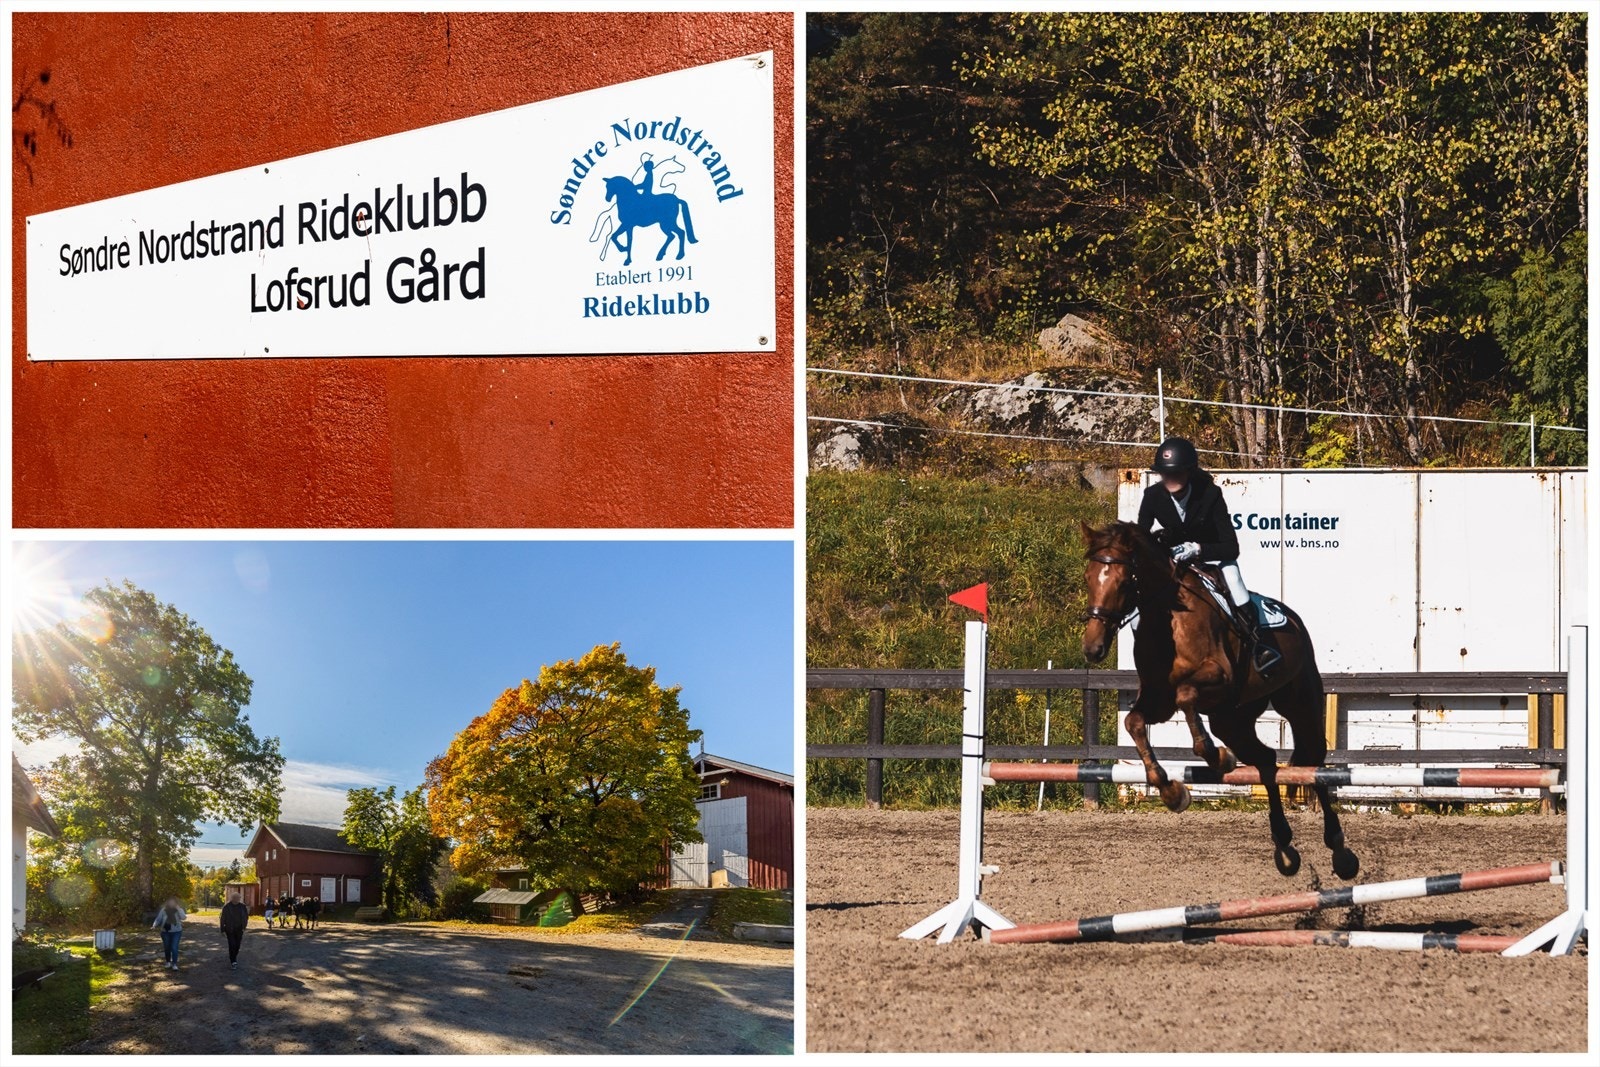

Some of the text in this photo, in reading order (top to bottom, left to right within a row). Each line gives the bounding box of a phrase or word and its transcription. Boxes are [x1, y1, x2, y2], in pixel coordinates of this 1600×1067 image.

[549, 116, 744, 225] Søndre Nordstrand
[59, 171, 488, 278] Søndre Nordstrand Rideklubb
[250, 246, 486, 314] Lofsrud Gård
[595, 265, 694, 287] Etablert 1991
[582, 291, 710, 319] Rideklubb
[1260, 538, 1339, 548] www.bns.no
